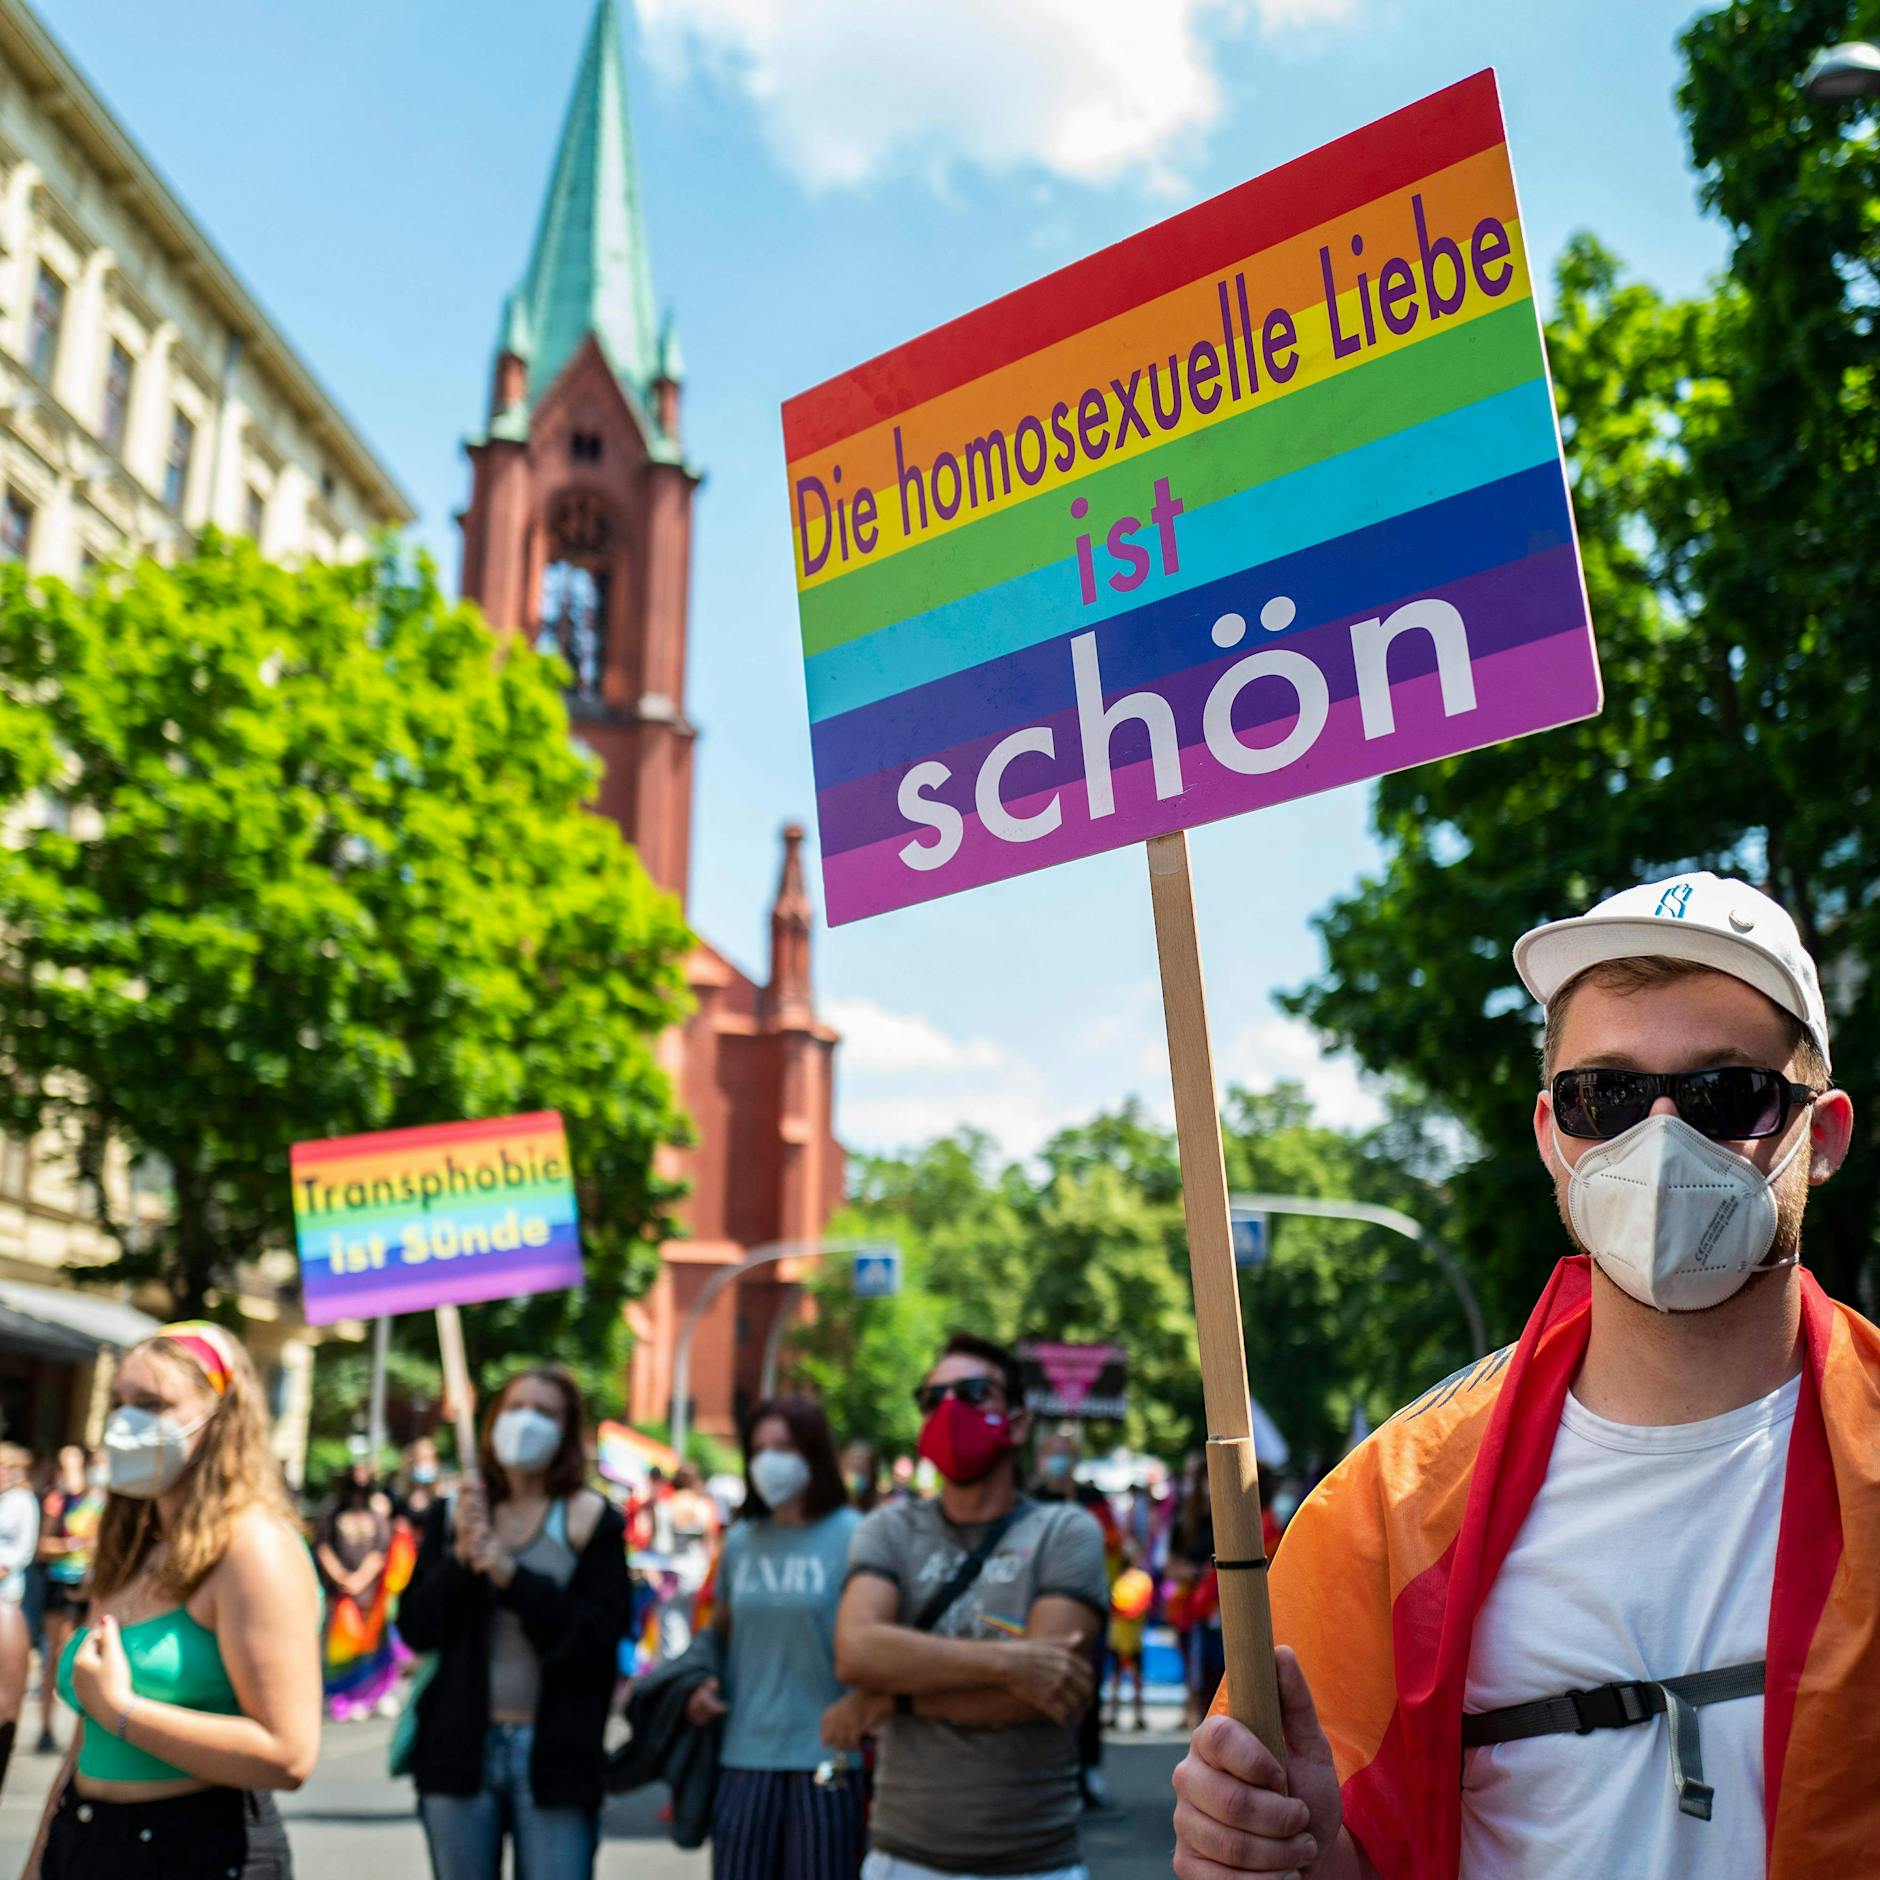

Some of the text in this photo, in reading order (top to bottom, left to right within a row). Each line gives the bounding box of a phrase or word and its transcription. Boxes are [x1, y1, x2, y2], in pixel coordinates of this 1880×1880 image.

[796, 193, 1514, 577] Die homosexuelle Liebe
[1070, 476, 1184, 606] ist
[898, 596, 1478, 872] schön
[302, 1147, 563, 1214] Transphobie
[329, 1209, 550, 1275] ist Sünde
